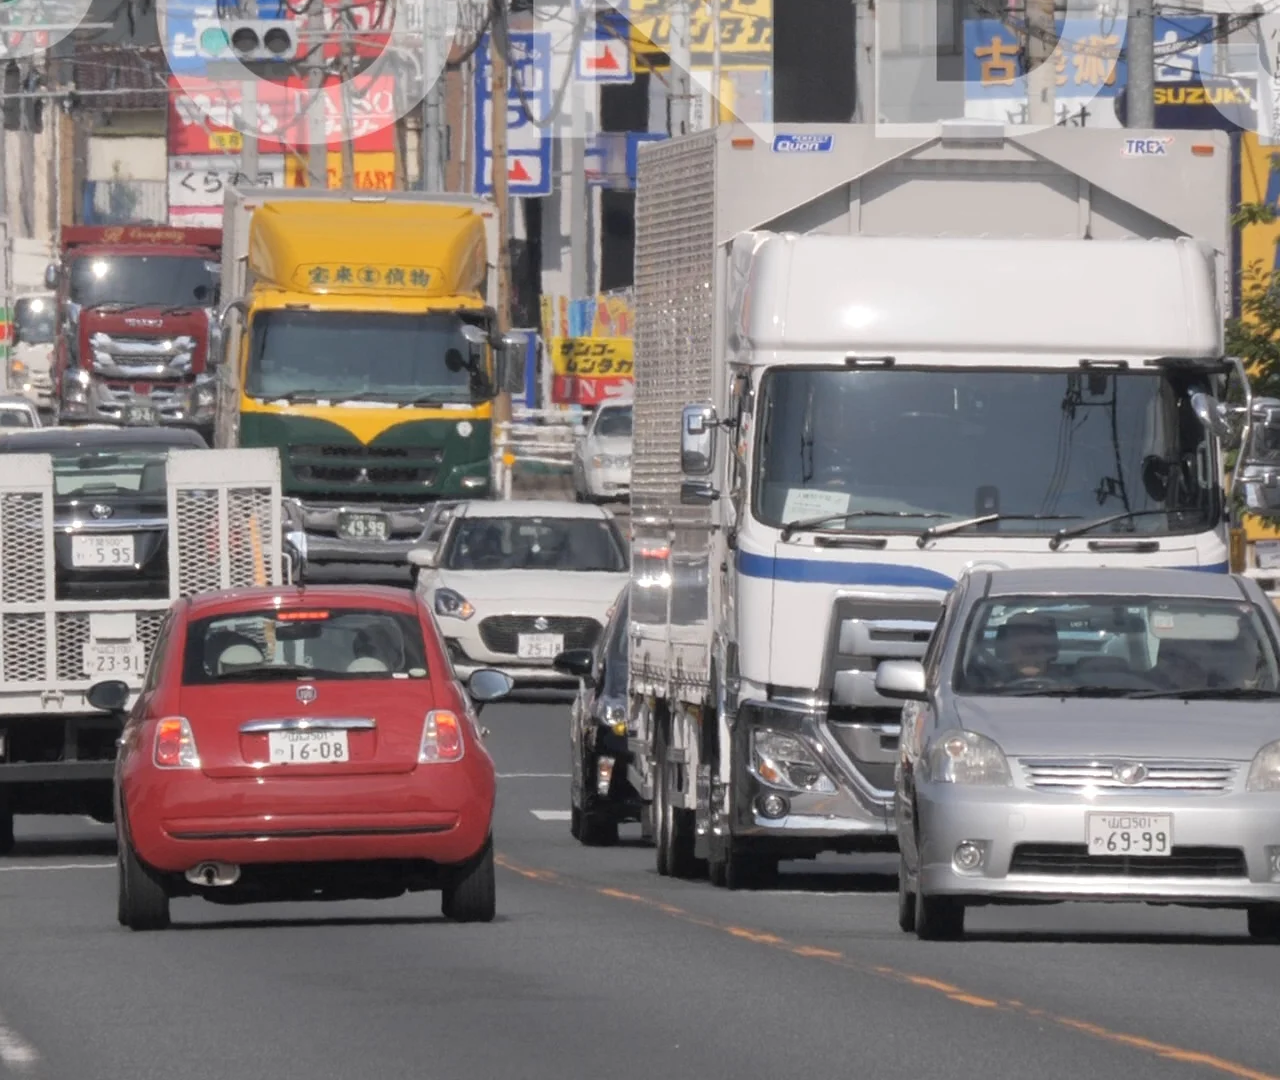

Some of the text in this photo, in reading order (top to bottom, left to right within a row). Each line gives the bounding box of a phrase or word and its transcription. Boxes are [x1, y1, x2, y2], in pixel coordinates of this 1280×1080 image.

[1124, 139, 1167, 154] TREX
[96, 656, 139, 671] 23-91
[289, 742, 344, 760] 16-08
[1106, 831, 1167, 852] 69-99
